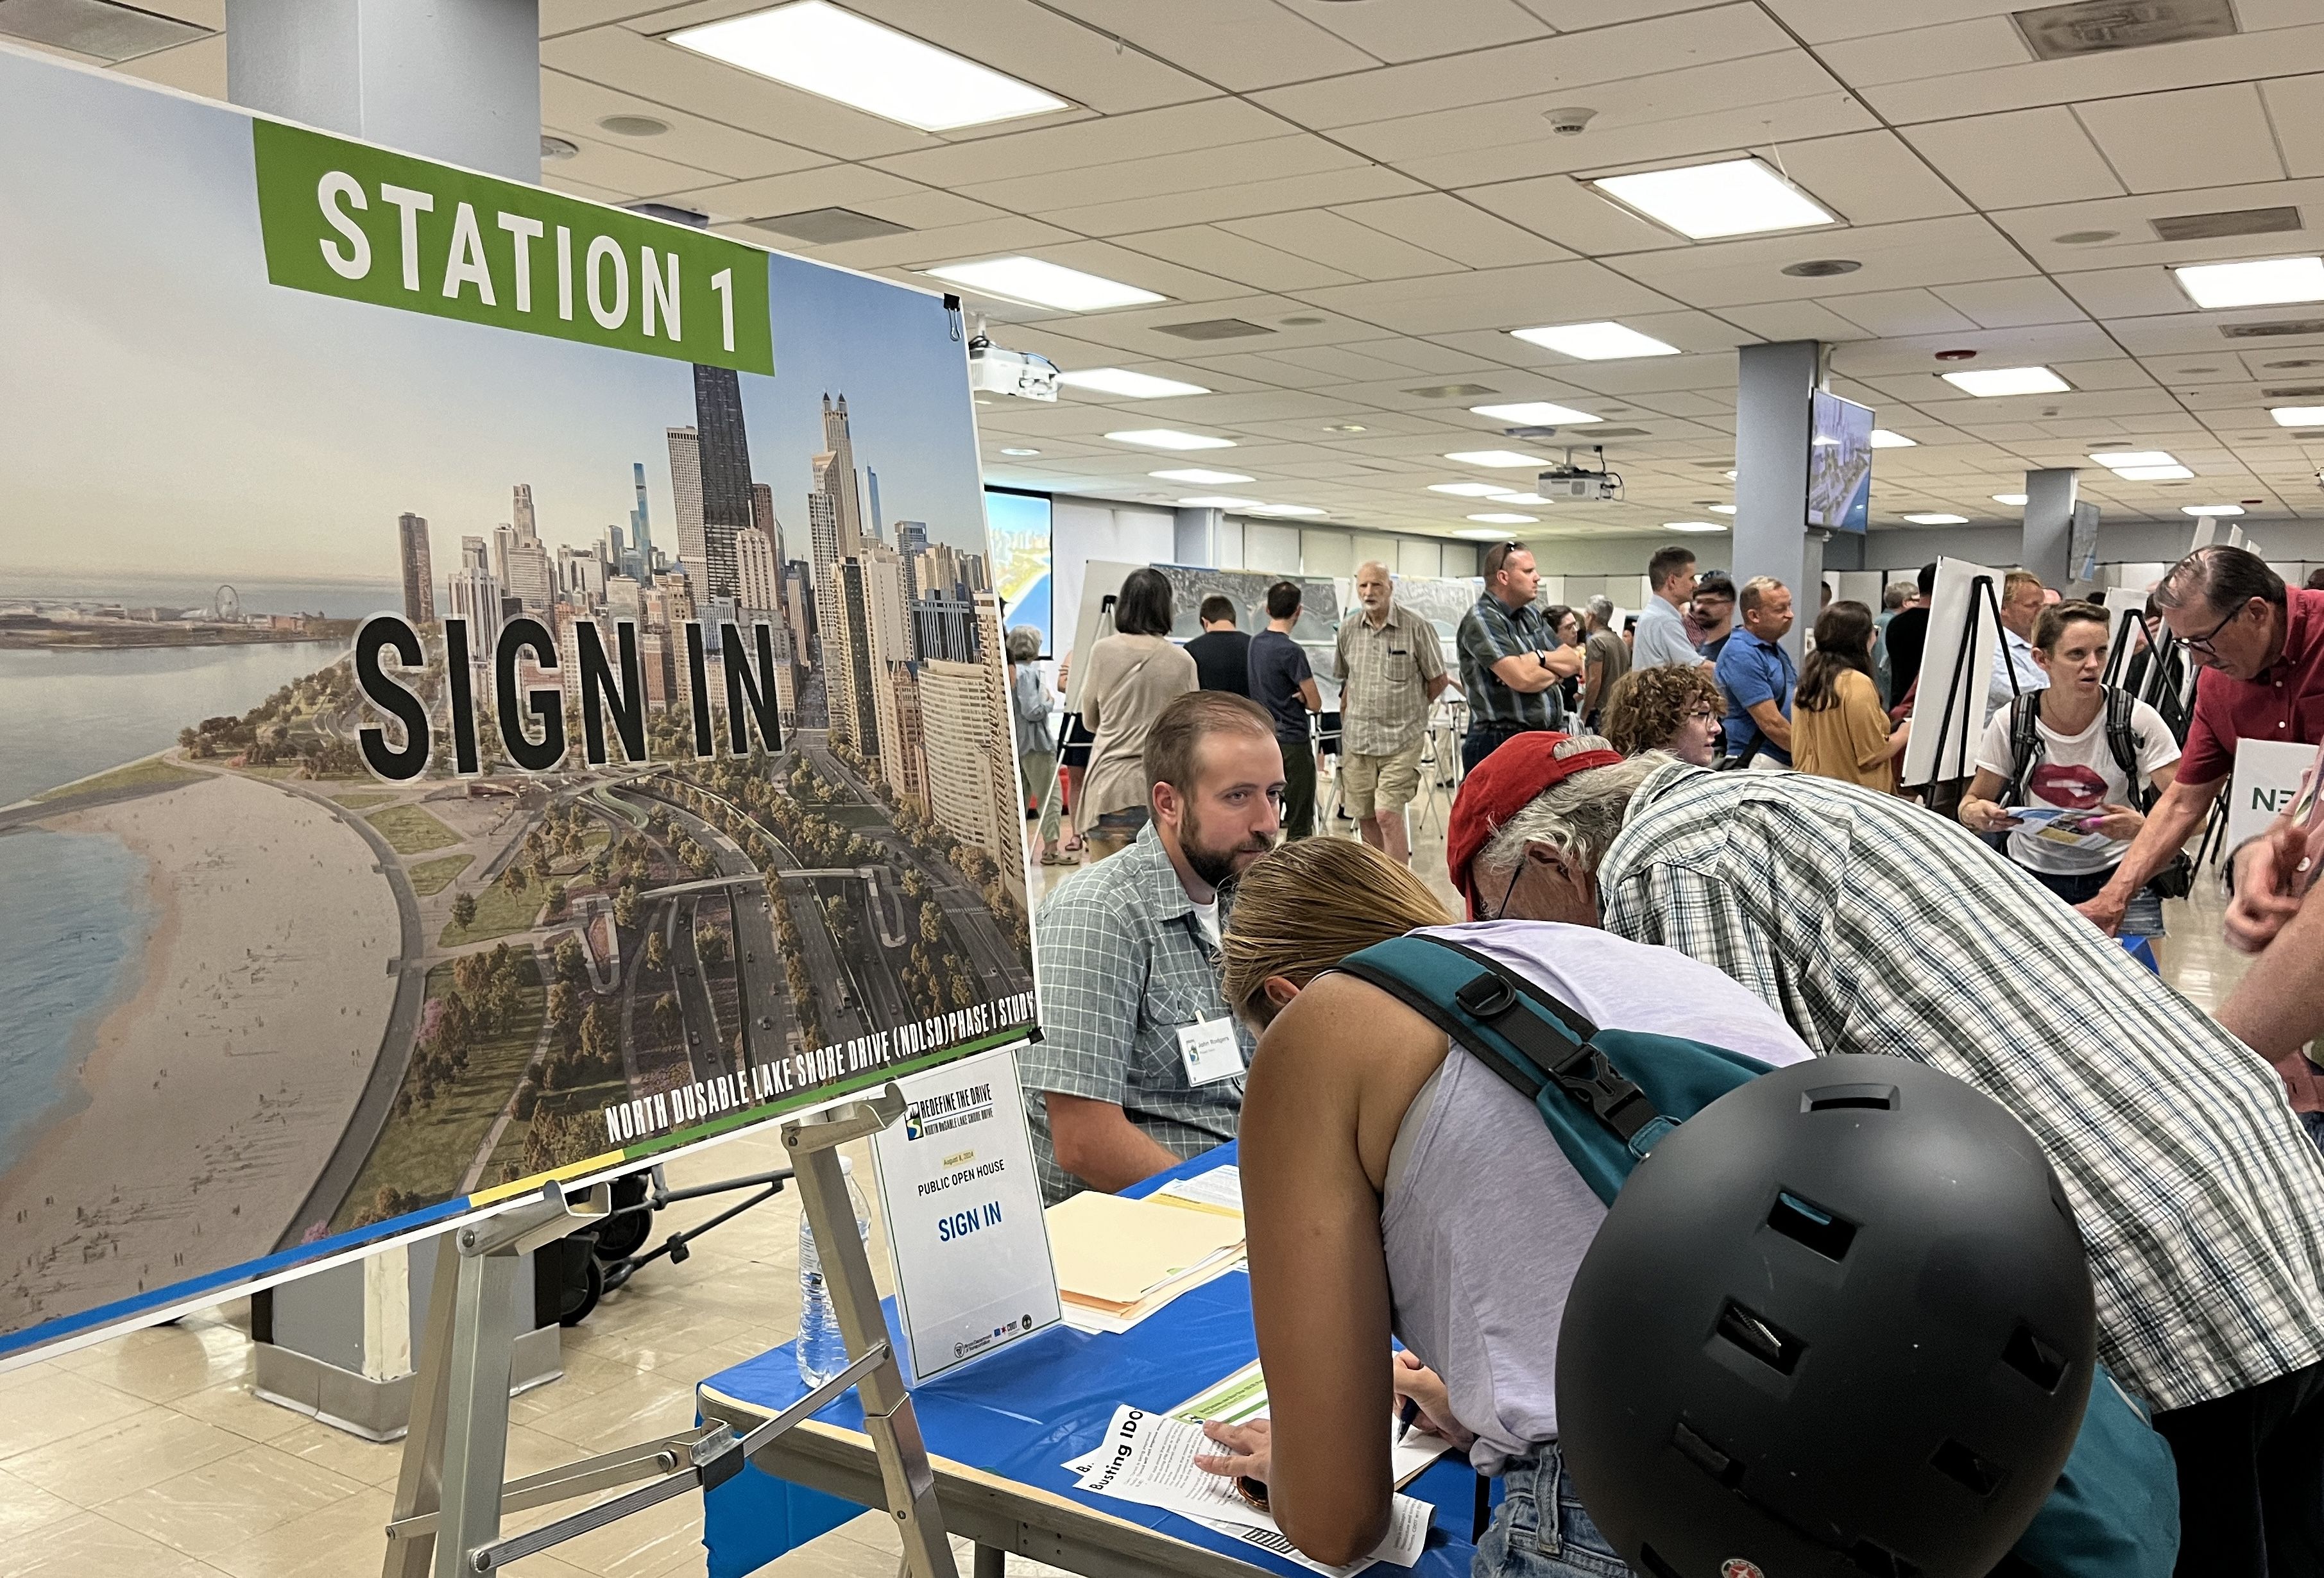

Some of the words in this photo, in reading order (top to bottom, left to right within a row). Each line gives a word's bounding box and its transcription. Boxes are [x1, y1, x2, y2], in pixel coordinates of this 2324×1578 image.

[316, 170, 682, 343] STATION
[710, 267, 735, 352] 1
[353, 614, 647, 783] SIGN
[684, 620, 785, 759] IN
[605, 1092, 669, 1144] NORTH
[671, 1070, 749, 1124] DUSABLE
[751, 1057, 794, 1101] LAKE
[796, 1043, 846, 1087] SHORE
[847, 1030, 891, 1072] DRIVE
[998, 990, 1035, 1027] STUDY
[919, 1092, 957, 1119] REDEFINE
[956, 1089, 971, 1109] THE
[970, 1083, 993, 1105] DRIVE
[957, 1114, 968, 1127] LAKE
[918, 1176, 950, 1197] PUBLIC
[952, 1168, 975, 1186] OPEN
[976, 1159, 1005, 1178] HOUSE
[938, 1208, 980, 1242] SIGN
[982, 1200, 1002, 1227] IN
[1089, 1444, 1132, 1490] Busting
[1120, 1408, 1143, 1439] IDO
